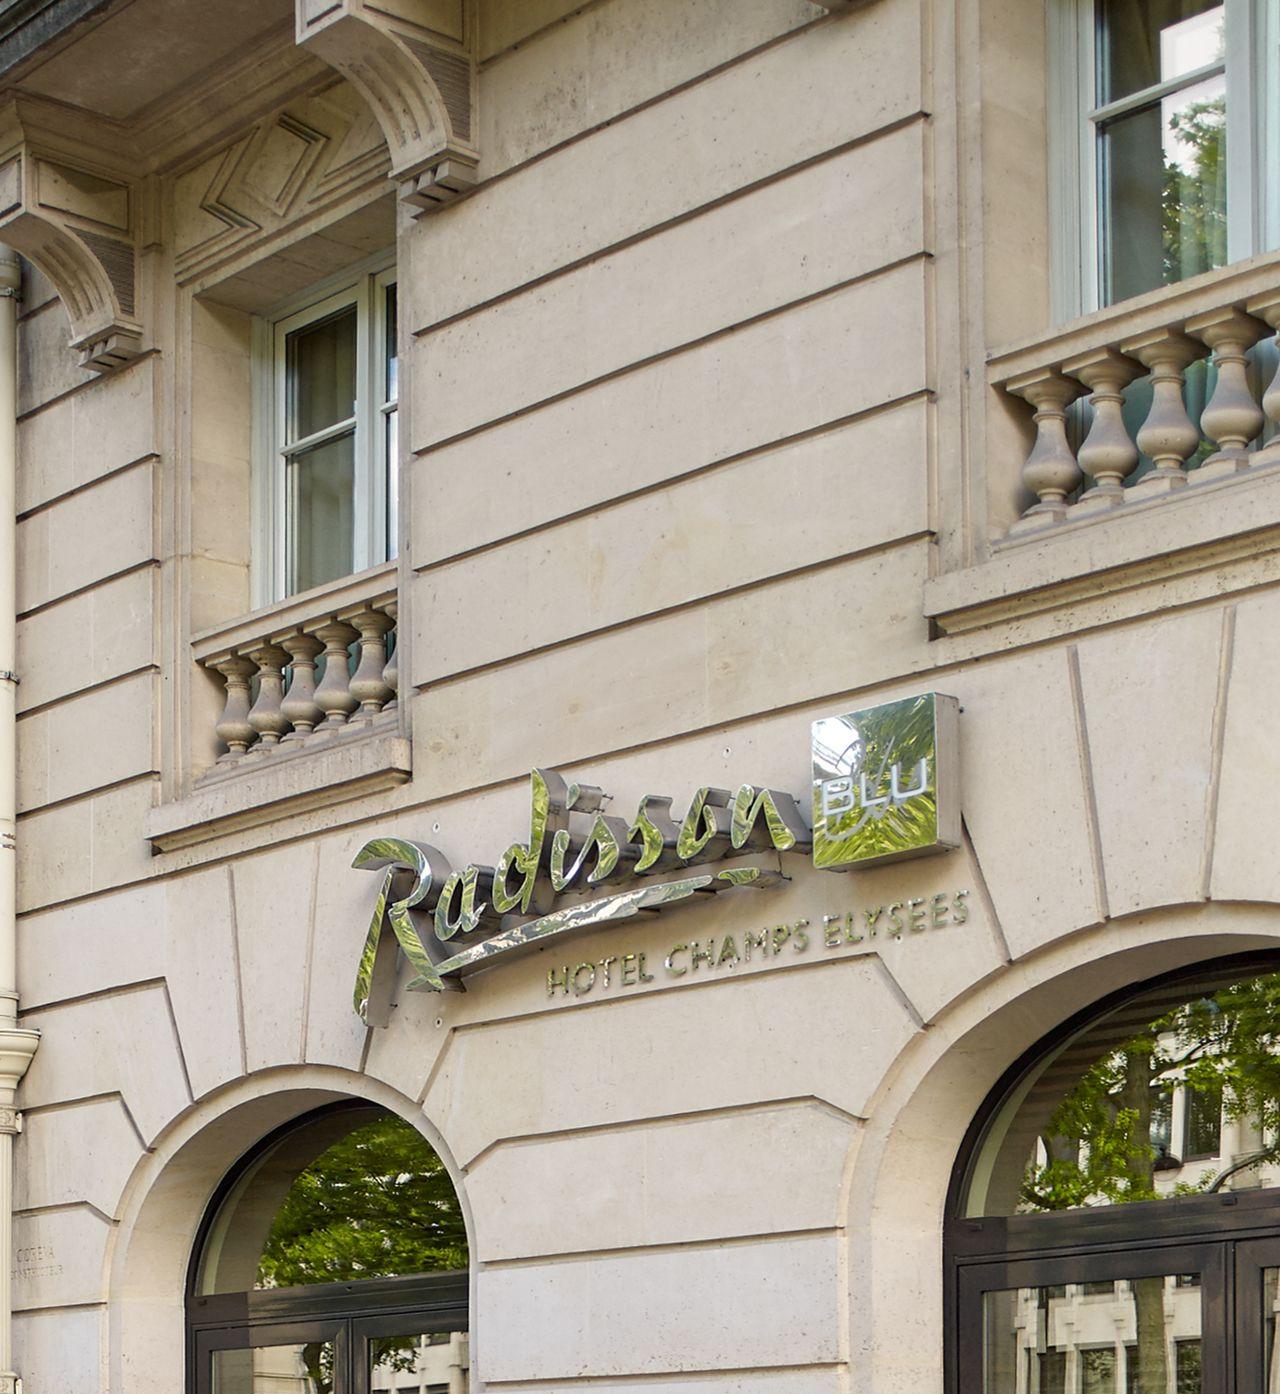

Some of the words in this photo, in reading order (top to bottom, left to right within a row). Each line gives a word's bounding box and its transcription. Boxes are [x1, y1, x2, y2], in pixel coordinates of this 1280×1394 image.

[350, 767, 802, 1027] Radisson
[821, 757, 928, 816] BLU
[545, 951, 655, 998] HOTEL
[664, 918, 810, 977] CHAMPS
[820, 889, 970, 949] ELYSEES
